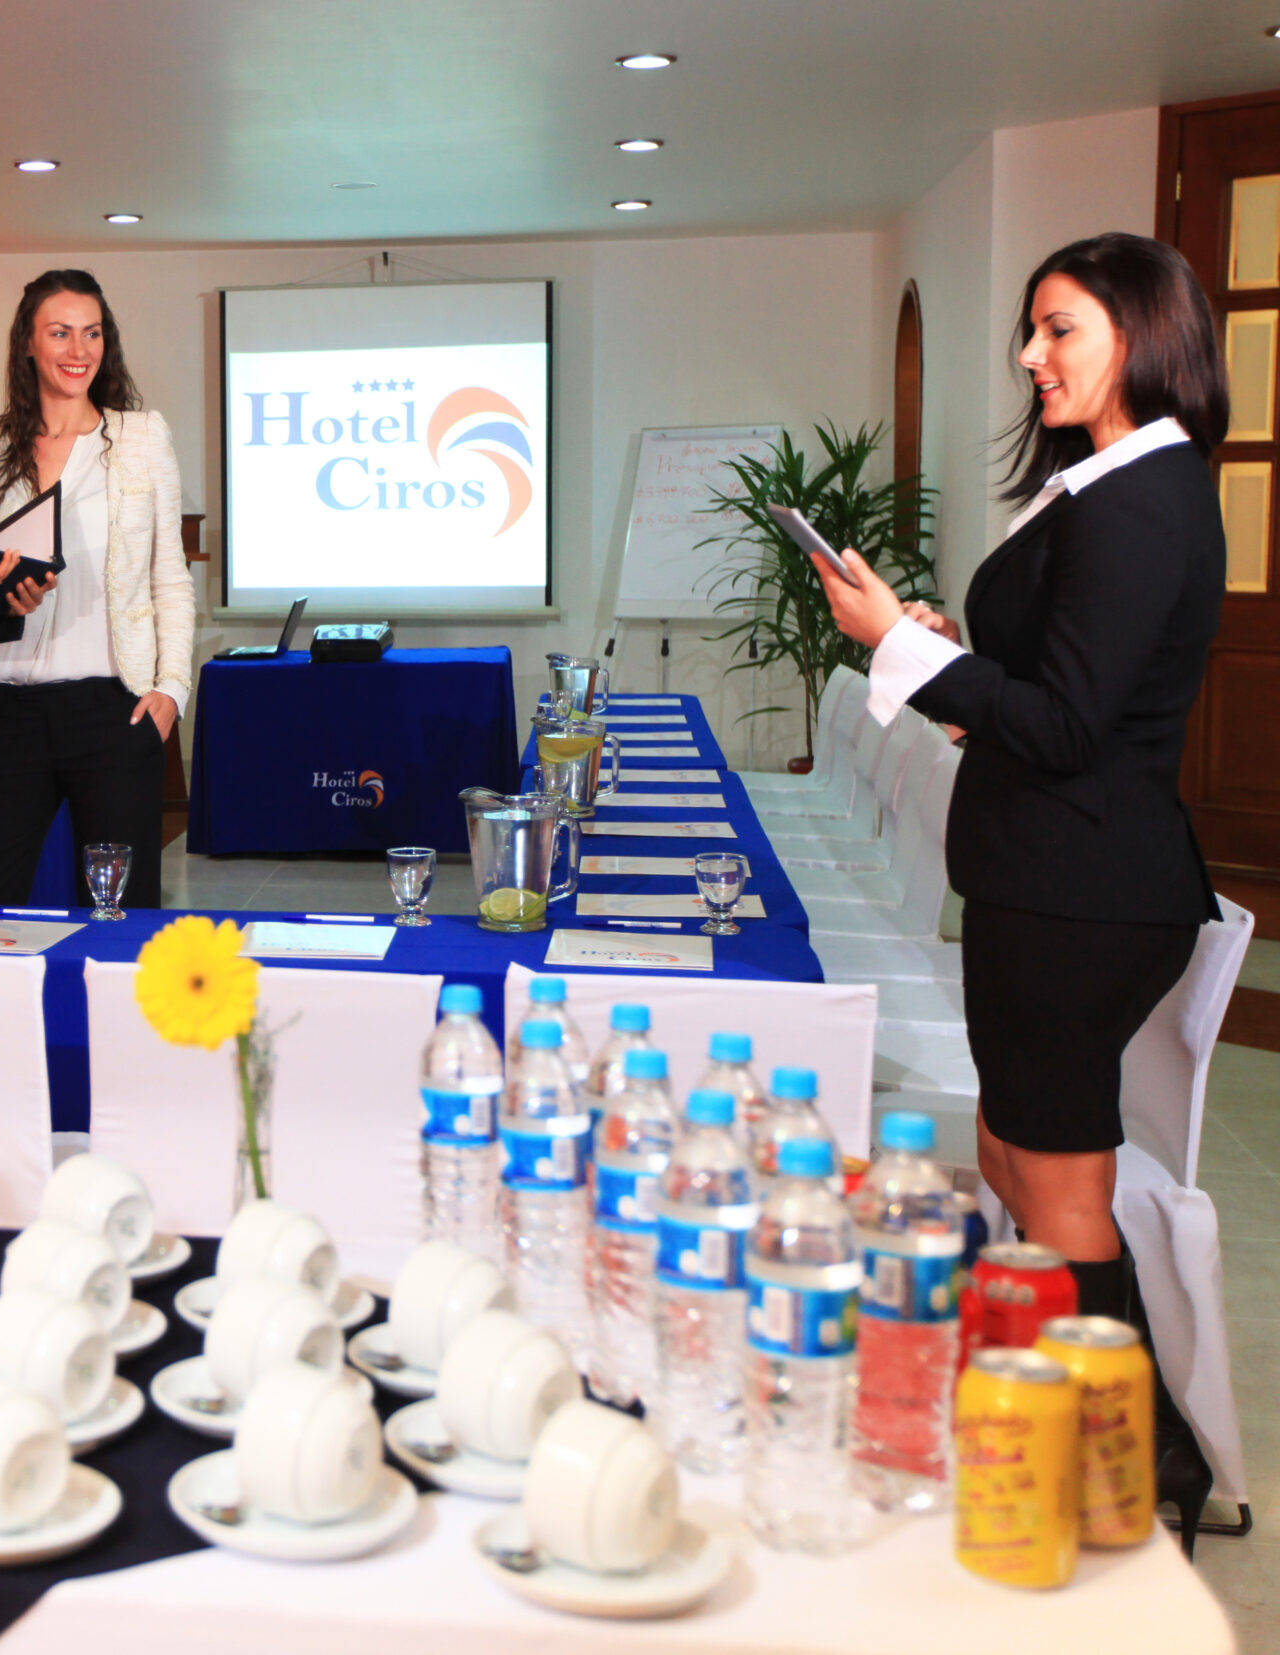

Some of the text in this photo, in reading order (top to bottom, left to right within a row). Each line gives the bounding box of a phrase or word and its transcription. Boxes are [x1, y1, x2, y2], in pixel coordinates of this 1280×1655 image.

[242, 390, 420, 447] Hotel
[315, 456, 487, 511] Ciros
[312, 771, 356, 788] Hotel
[331, 791, 373, 807] Ciros
